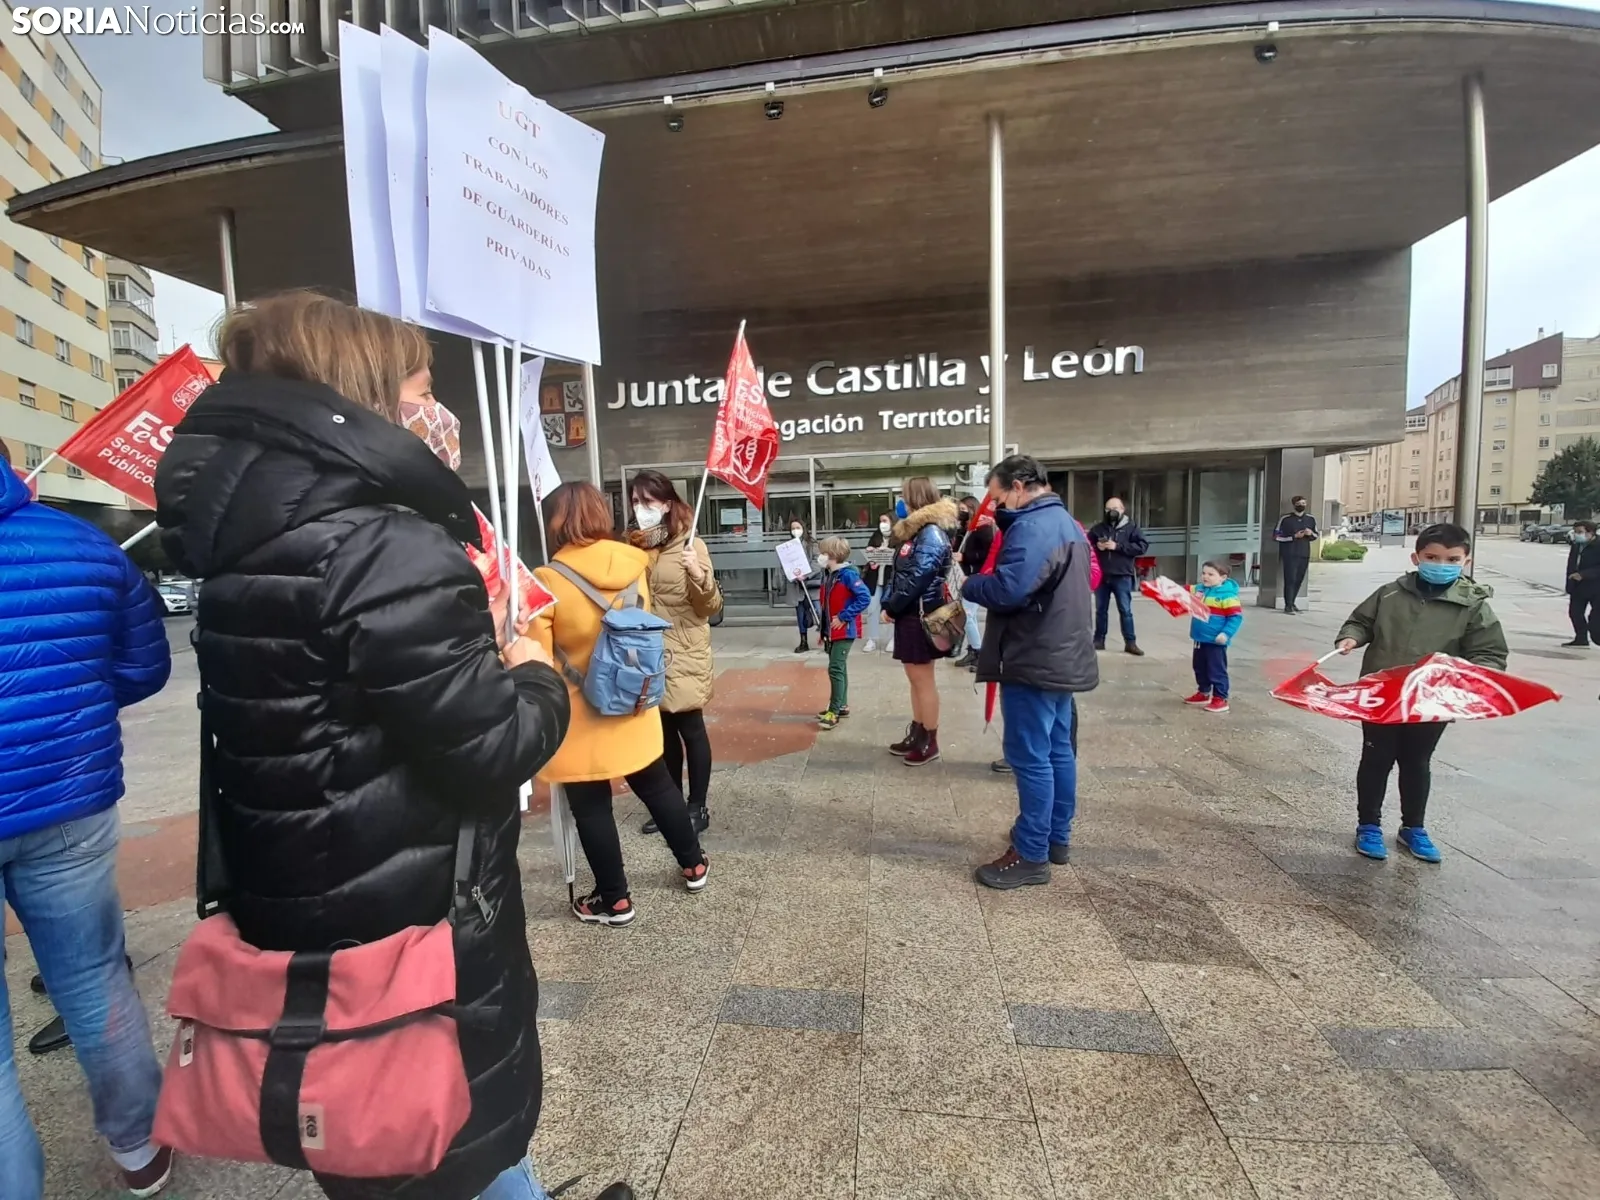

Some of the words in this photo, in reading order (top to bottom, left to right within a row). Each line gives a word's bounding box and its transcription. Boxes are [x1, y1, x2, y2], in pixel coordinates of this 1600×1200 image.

[498, 100, 540, 138] UGT
[488, 136, 521, 161] CON
[525, 156, 549, 180] LOS
[462, 151, 569, 226] TRABAJADORES
[462, 186, 482, 207] DE
[486, 236, 551, 280] PRIVADAS
[607, 374, 726, 410] Junta
[806, 354, 966, 395] Castilla
[1023, 339, 1144, 381] León
[879, 404, 990, 430] Territoria
